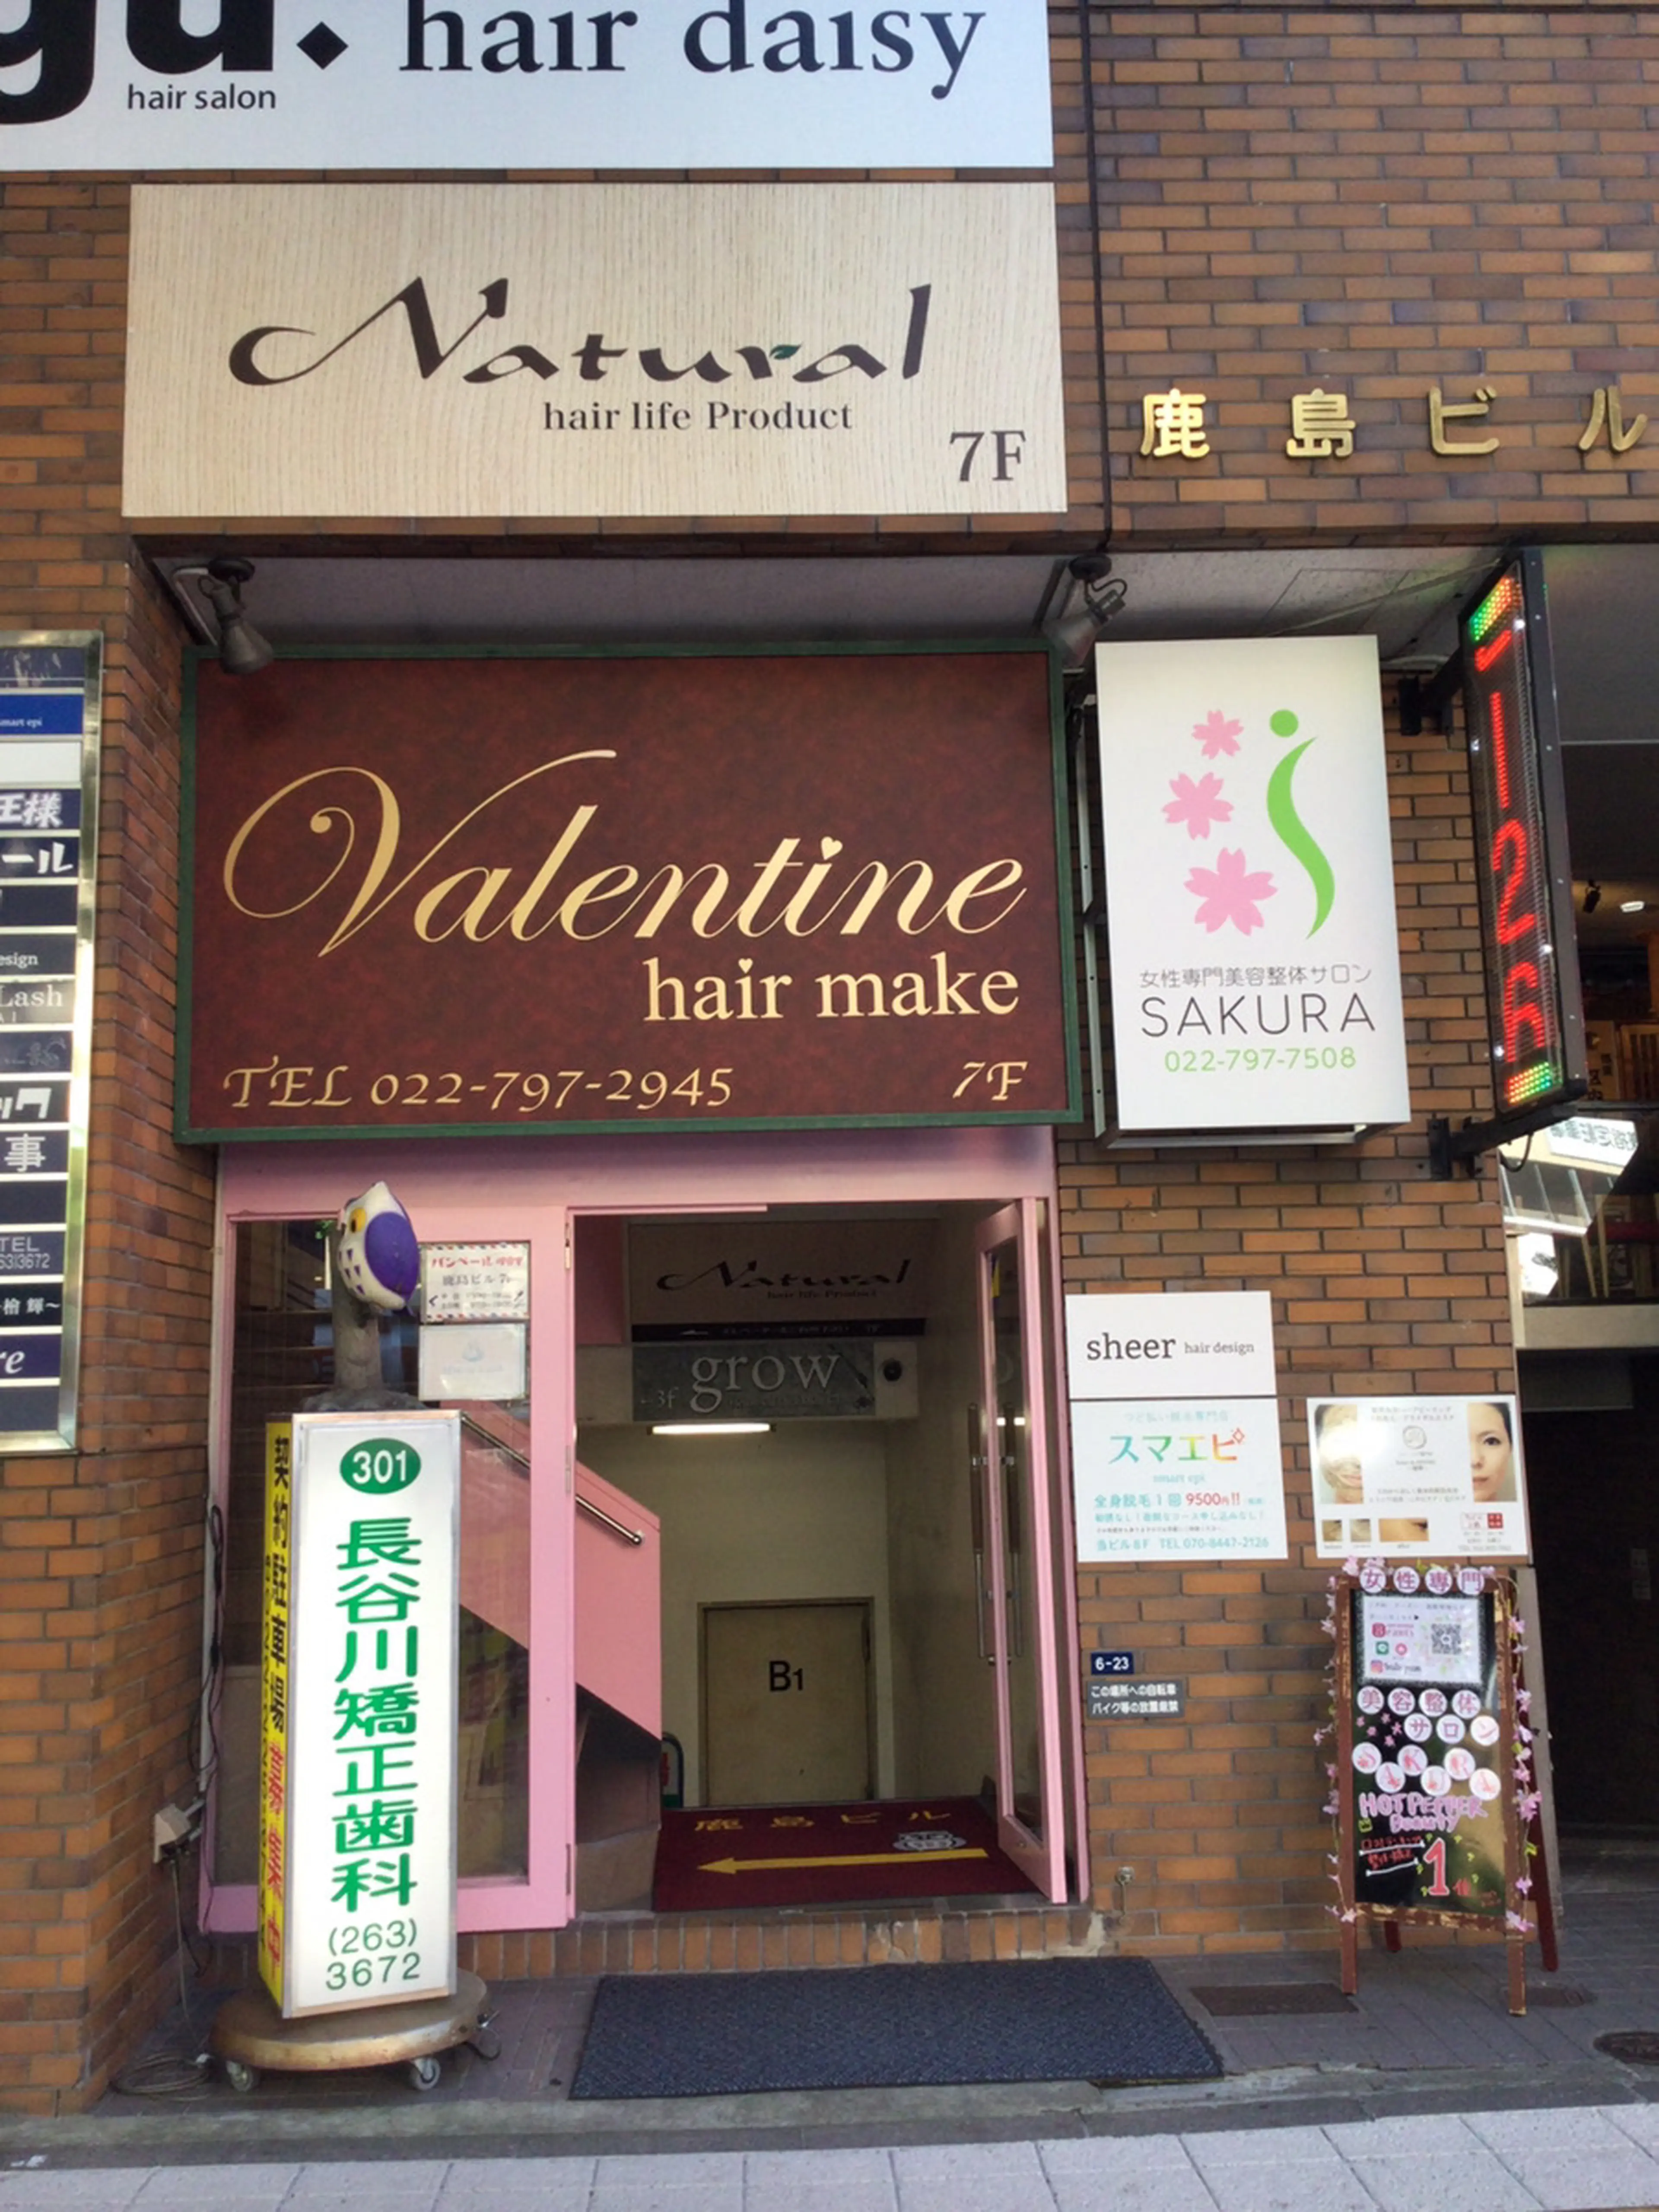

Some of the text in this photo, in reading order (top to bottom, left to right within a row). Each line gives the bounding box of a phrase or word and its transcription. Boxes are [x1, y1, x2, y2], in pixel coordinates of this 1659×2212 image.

[400, 0, 638, 73] hair
[683, 0, 985, 99] daisy
[128, 83, 276, 109] hair salon
[229, 276, 931, 386] Natural
[545, 402, 852, 429] hair life Product
[1140, 386, 1648, 458] 鹿島ビル
[950, 430, 1027, 482] 7F
[223, 749, 1027, 957] Valentine
[643, 951, 1019, 1021] hair make
[1141, 992, 1376, 1038] SAKURA
[1164, 1046, 1357, 1073] 022-797-7508
[223, 1055, 733, 1112] TEL 022-797-2945
[952, 1062, 1027, 1101] 7F
[656, 1259, 912, 1290] Natural
[1087, 1332, 1255, 1360] sheer hair design
[690, 1353, 843, 1413] grow
[1108, 1427, 1245, 1465] スマエピ
[352, 1449, 408, 1484] 301
[769, 1659, 803, 1692] B1
[1095, 1656, 1129, 1671] 6-23
[331, 1517, 422, 1912] 長谷川矯正歯科
[329, 1918, 417, 1957] (263)
[326, 1951, 421, 1990] 3672
